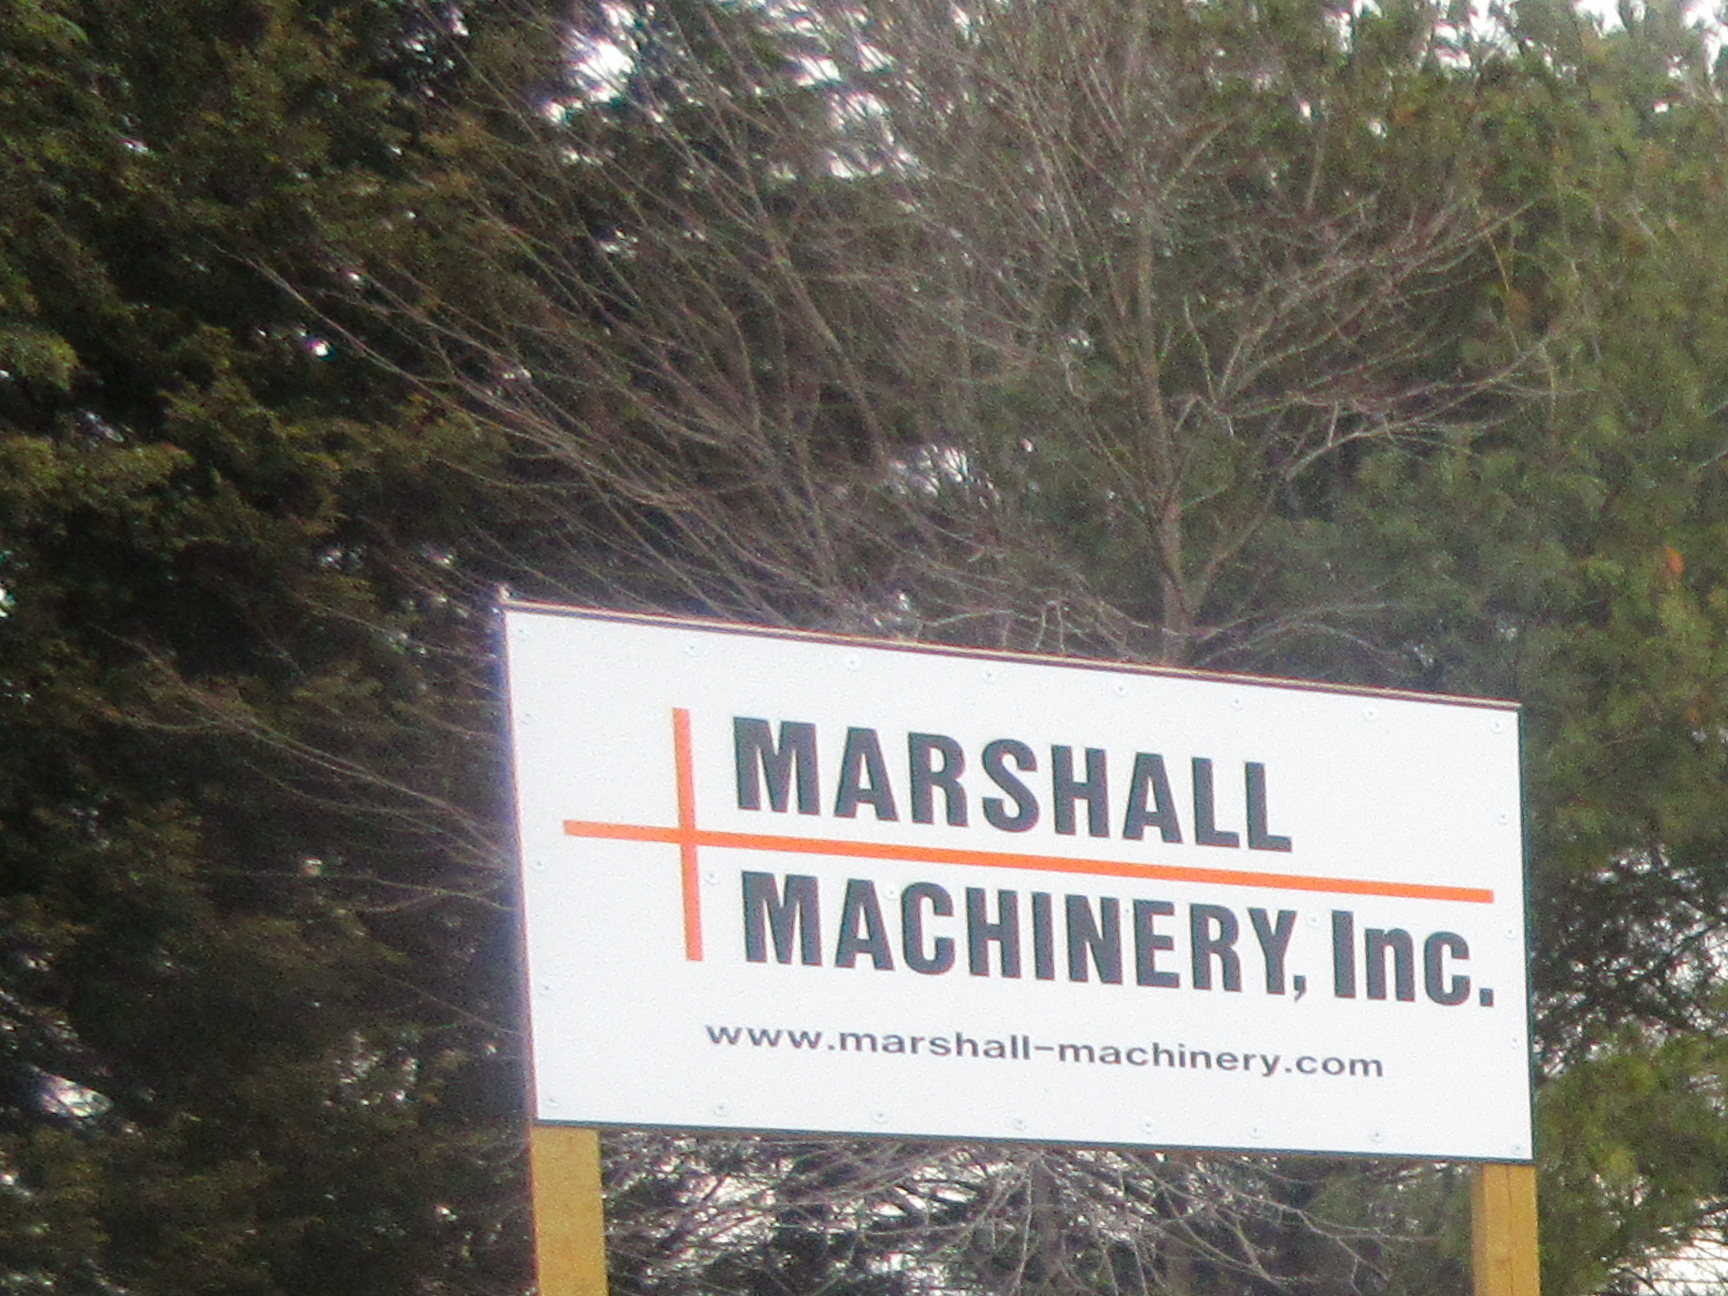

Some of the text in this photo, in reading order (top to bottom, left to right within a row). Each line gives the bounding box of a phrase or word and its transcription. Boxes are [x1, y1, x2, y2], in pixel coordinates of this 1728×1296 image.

[734, 718, 1291, 851] MARSHALL
[741, 871, 1493, 1006] MACHINERY, Inc.
[705, 1022, 1385, 1077] www.marshall-machinery.com
